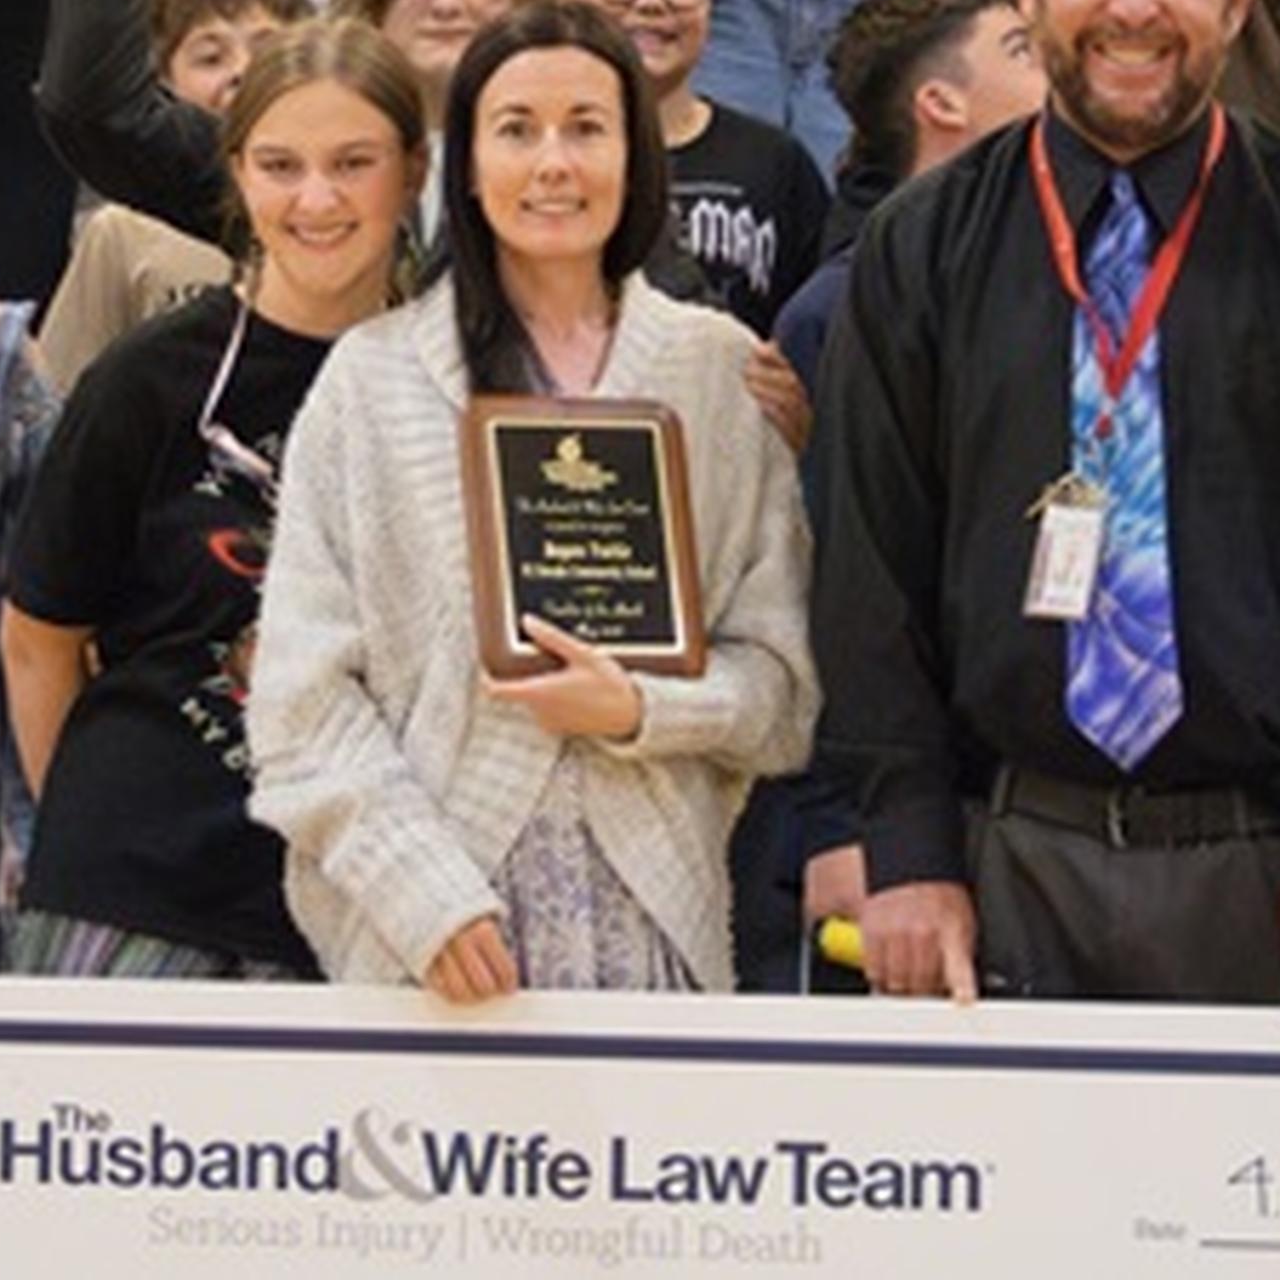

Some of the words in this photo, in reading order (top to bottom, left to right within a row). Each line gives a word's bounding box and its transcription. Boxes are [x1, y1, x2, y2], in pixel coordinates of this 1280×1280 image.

[52, 1103, 113, 1134] The
[339, 1106, 438, 1204] &
[422, 1129, 592, 1199] Wife
[610, 1136, 768, 1205] Law
[776, 1141, 982, 1213] Team
[147, 1207, 305, 1249] Serious
[317, 1212, 444, 1261] Injury
[482, 1217, 683, 1267] Wrongful
[699, 1223, 823, 1267] Death
